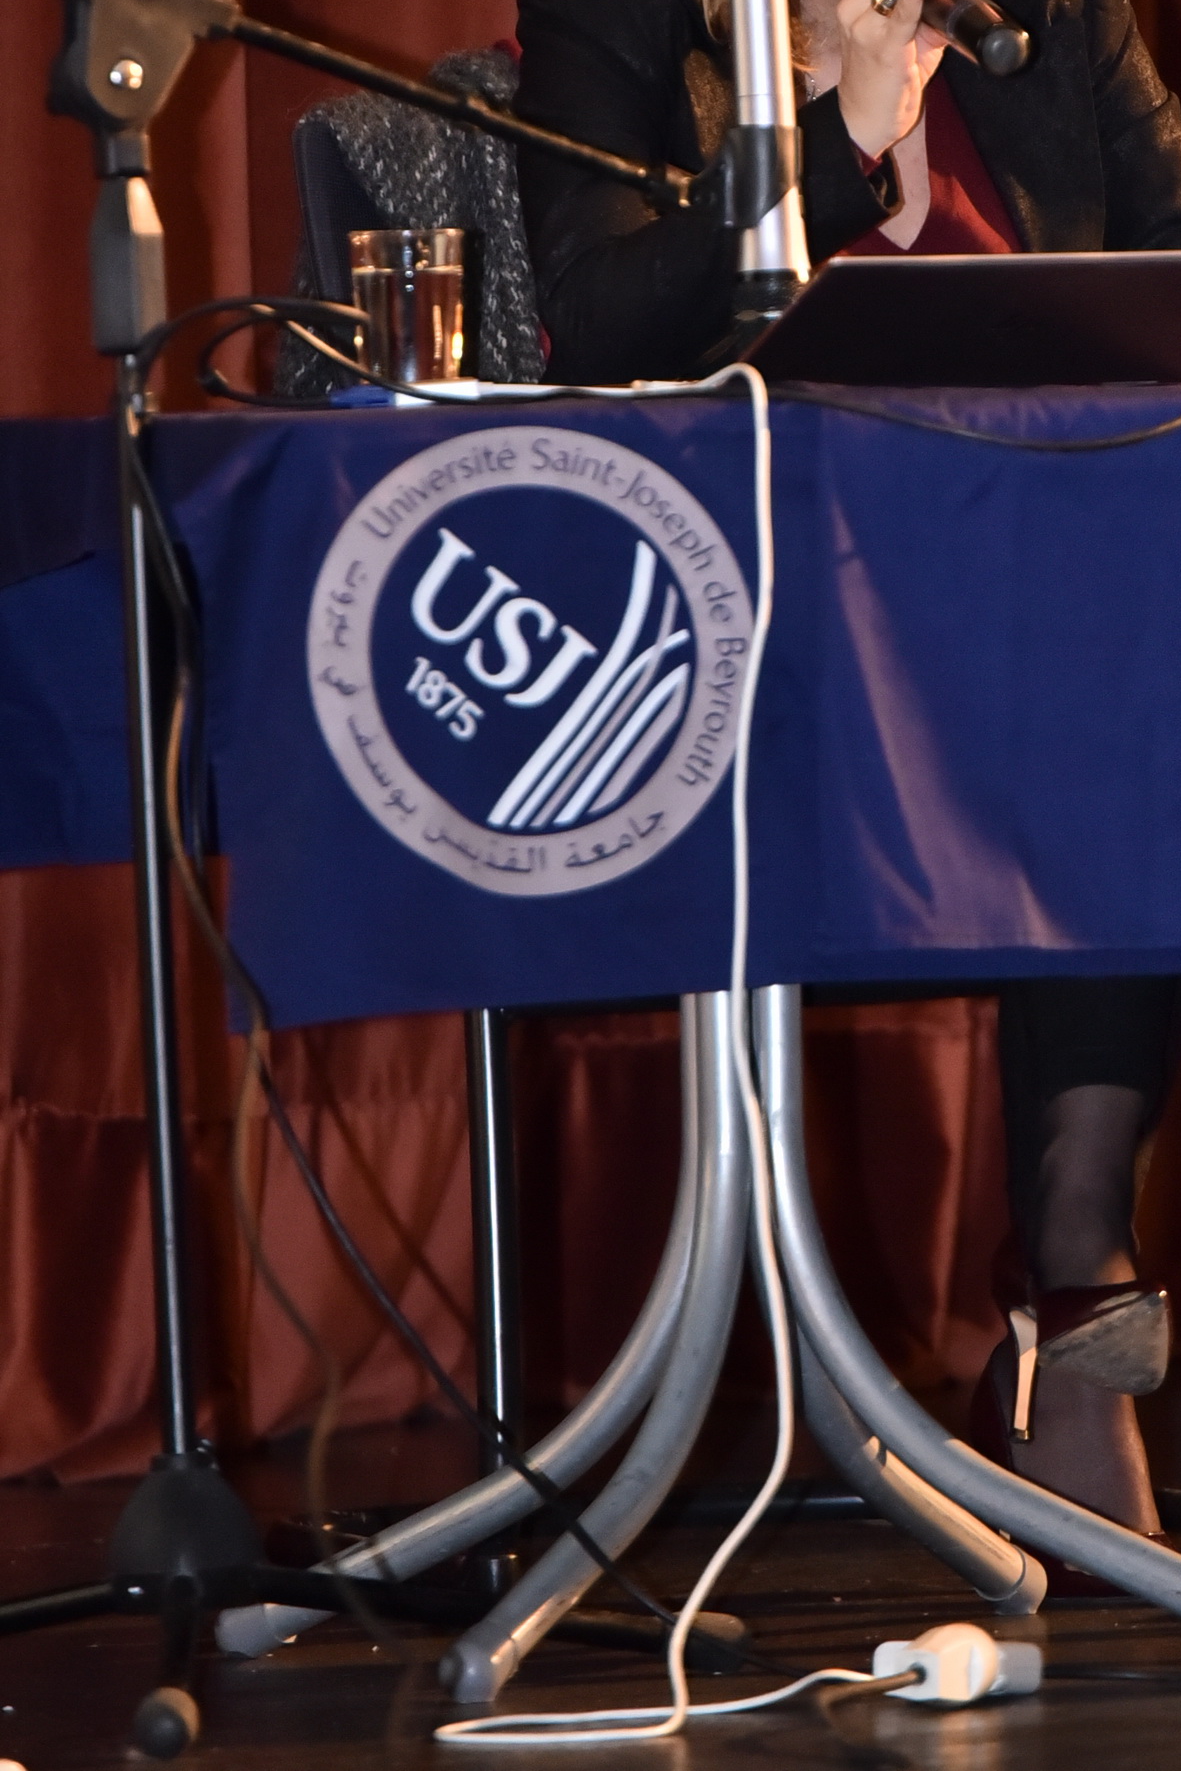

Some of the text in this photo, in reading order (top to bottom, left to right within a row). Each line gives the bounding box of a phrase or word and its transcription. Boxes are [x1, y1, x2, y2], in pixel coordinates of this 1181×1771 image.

[362, 437, 746, 786] Université Saint-Joseph de Beyrouth
[411, 528, 599, 708] USJ
[405, 657, 485, 742] 1875
[565, 810, 665, 868] جامعة
